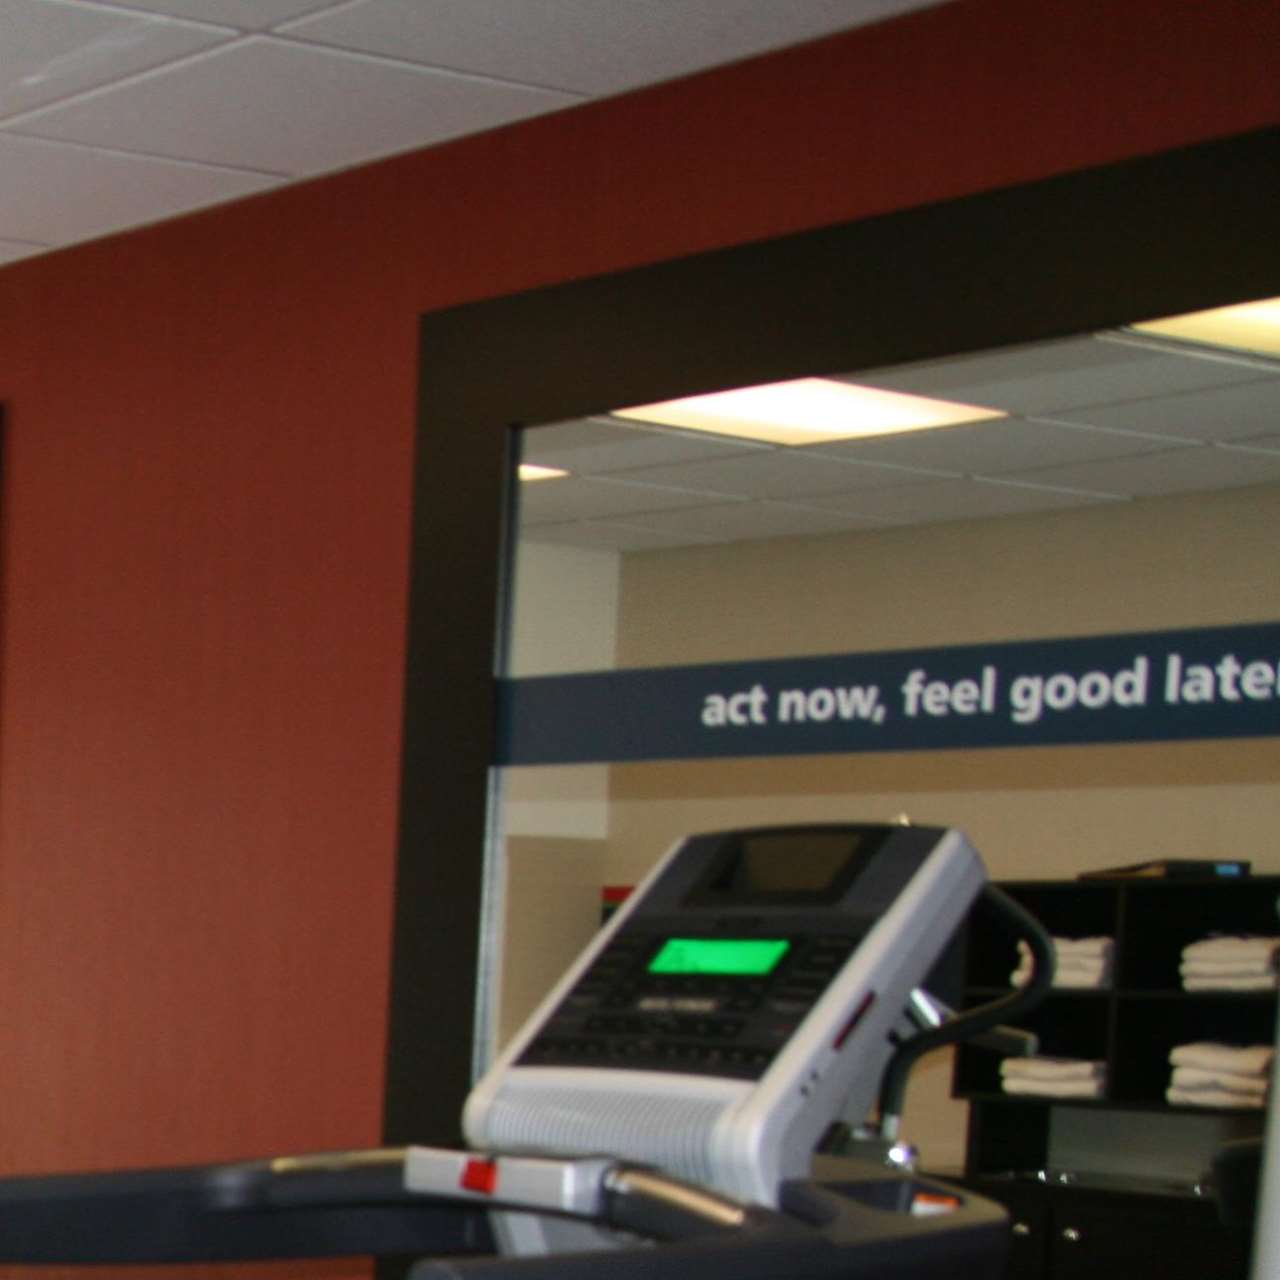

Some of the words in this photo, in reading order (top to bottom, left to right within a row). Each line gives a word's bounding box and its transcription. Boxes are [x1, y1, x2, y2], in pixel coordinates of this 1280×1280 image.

[701, 684, 768, 726] act
[778, 685, 886, 724] now,
[901, 666, 996, 716] feel
[1010, 655, 1149, 723] good
[1164, 653, 1280, 704] late
